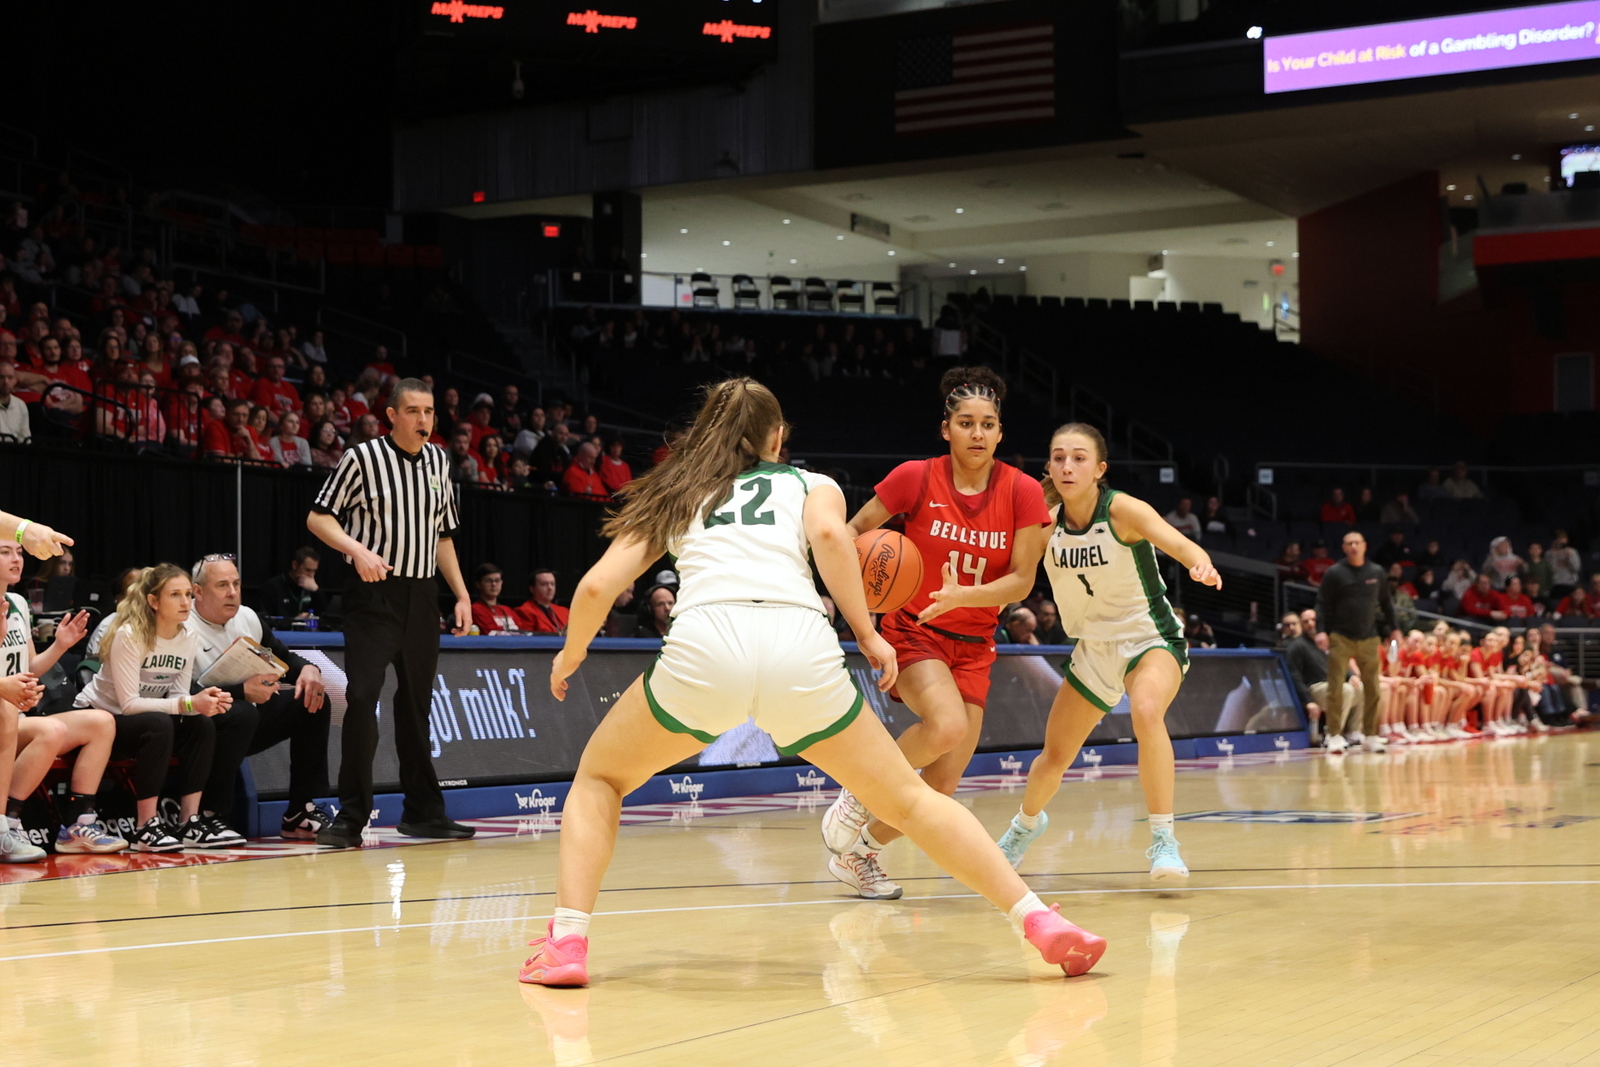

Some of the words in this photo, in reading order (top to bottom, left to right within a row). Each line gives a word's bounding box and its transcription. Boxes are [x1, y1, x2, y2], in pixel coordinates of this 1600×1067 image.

[1267, 58, 1280, 73] Is
[1282, 56, 1316, 71] Your
[1317, 48, 1357, 67] Child
[1357, 47, 1373, 63] at
[1375, 43, 1407, 61] Risk
[1409, 39, 1428, 58] of
[1428, 42, 1440, 55] a
[1441, 32, 1517, 51] Gambling
[1518, 21, 1595, 45] Disorder?
[702, 476, 776, 530] 22
[929, 519, 1007, 550] BELLEVUE
[868, 543, 895, 597] Rawlings
[948, 550, 988, 586] 14
[1051, 545, 1109, 569] LAUREL
[1077, 574, 1094, 597] 1
[6, 652, 22, 677] 21
[458, 668, 537, 740] milk?
[529, 789, 556, 814] Kroger
[681, 775, 704, 801] Kroger
